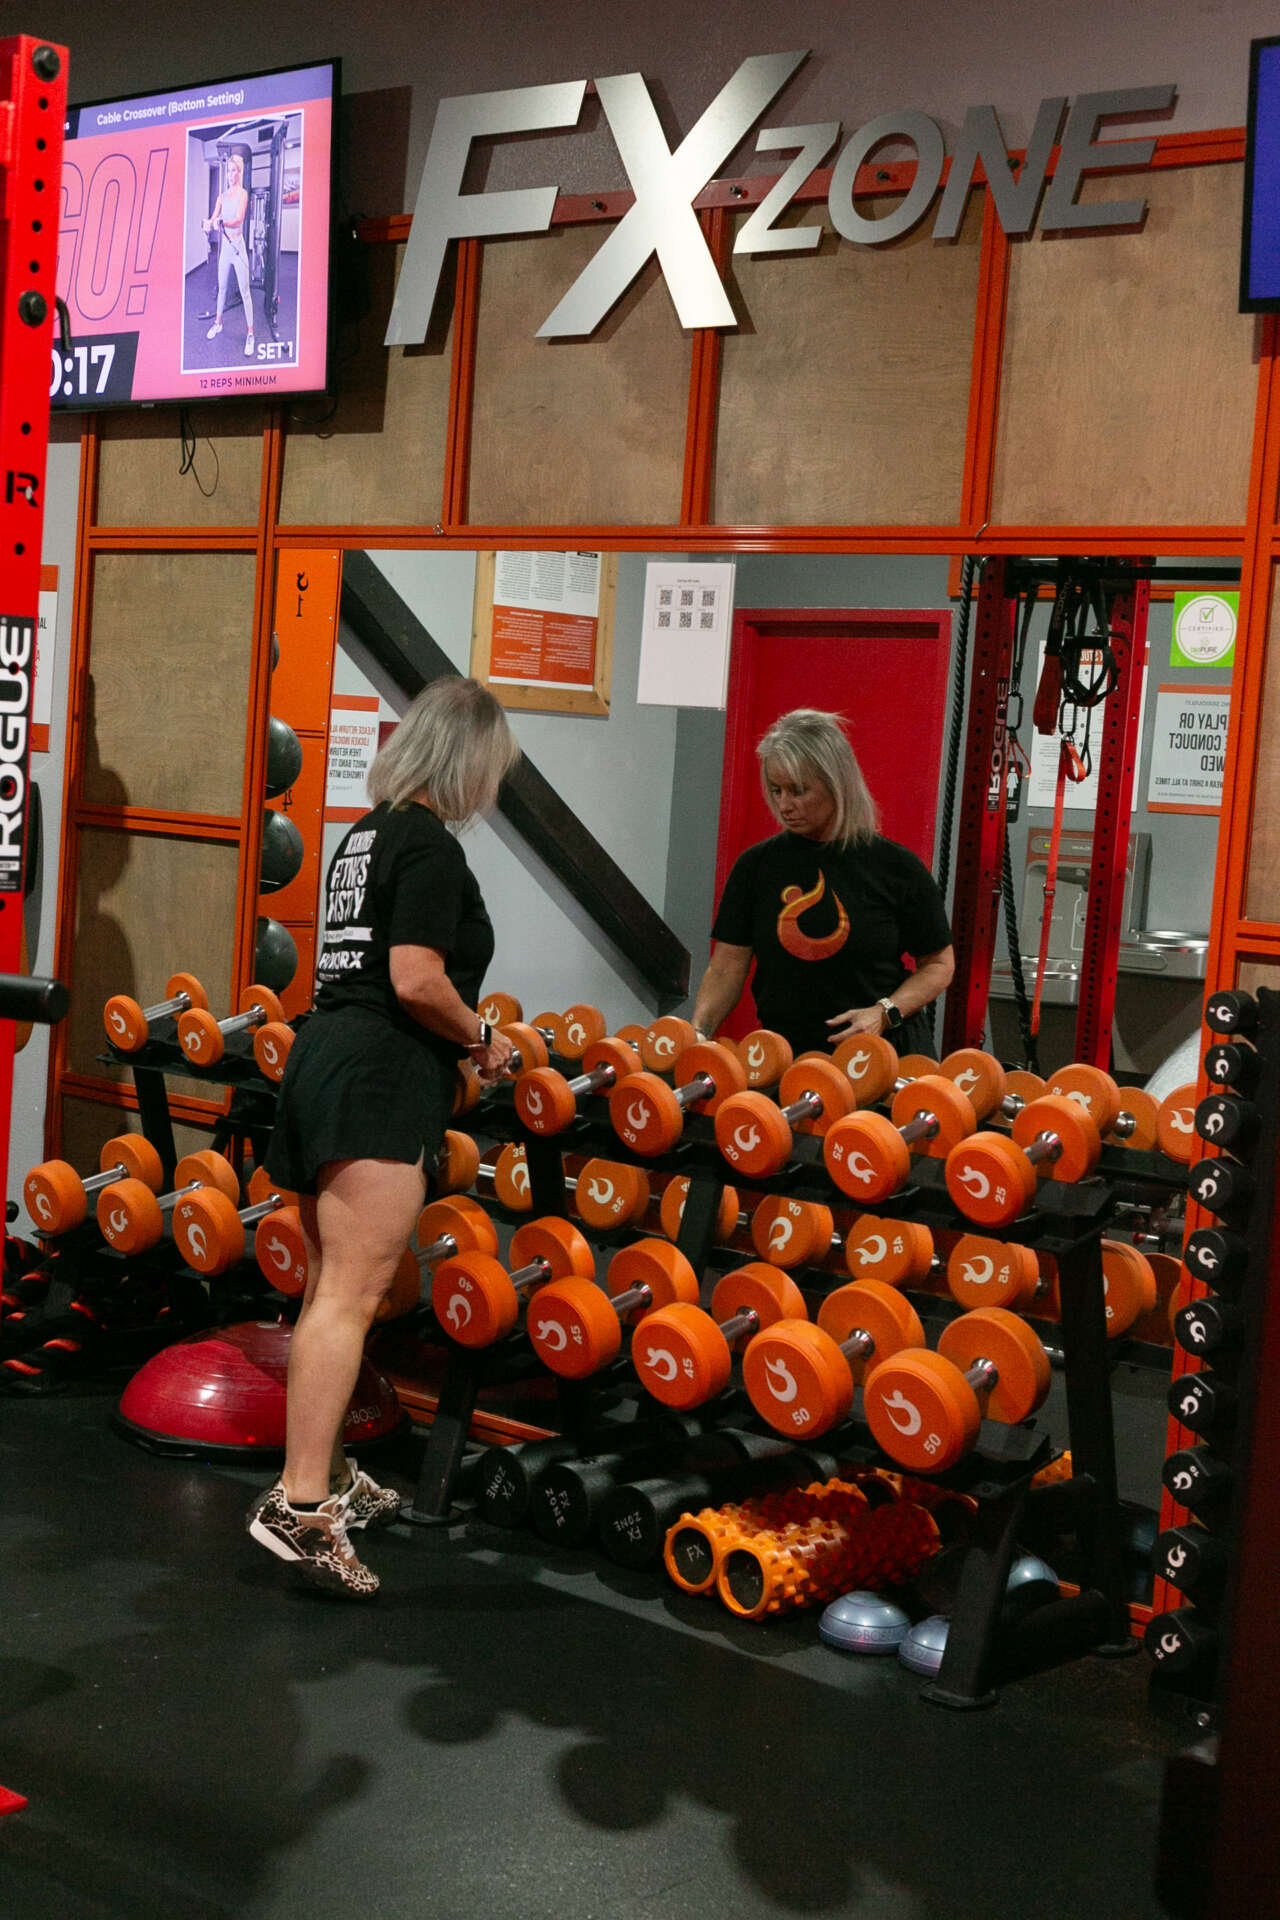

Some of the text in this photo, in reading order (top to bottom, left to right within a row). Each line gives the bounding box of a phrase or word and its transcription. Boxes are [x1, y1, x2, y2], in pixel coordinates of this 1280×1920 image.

[96, 89, 245, 126] Cable Crossover (Bottom Setting)
[383, 48, 1178, 346] FX ZONE
[256, 340, 294, 360] SET 1
[200, 375, 277, 389] 12 REPS MINIMUM
[0, 625, 32, 857] ROGUE
[622, 1127, 637, 1143] 20
[725, 1144, 739, 1161] 20
[831, 1141, 843, 1161] 25
[993, 1185, 1006, 1205] 25
[457, 1277, 472, 1292] 40
[570, 1325, 582, 1345] 45
[682, 1358, 694, 1379] 45
[790, 1407, 810, 1426] 50
[923, 1433, 942, 1455] 50
[686, 1543, 705, 1562] FX
